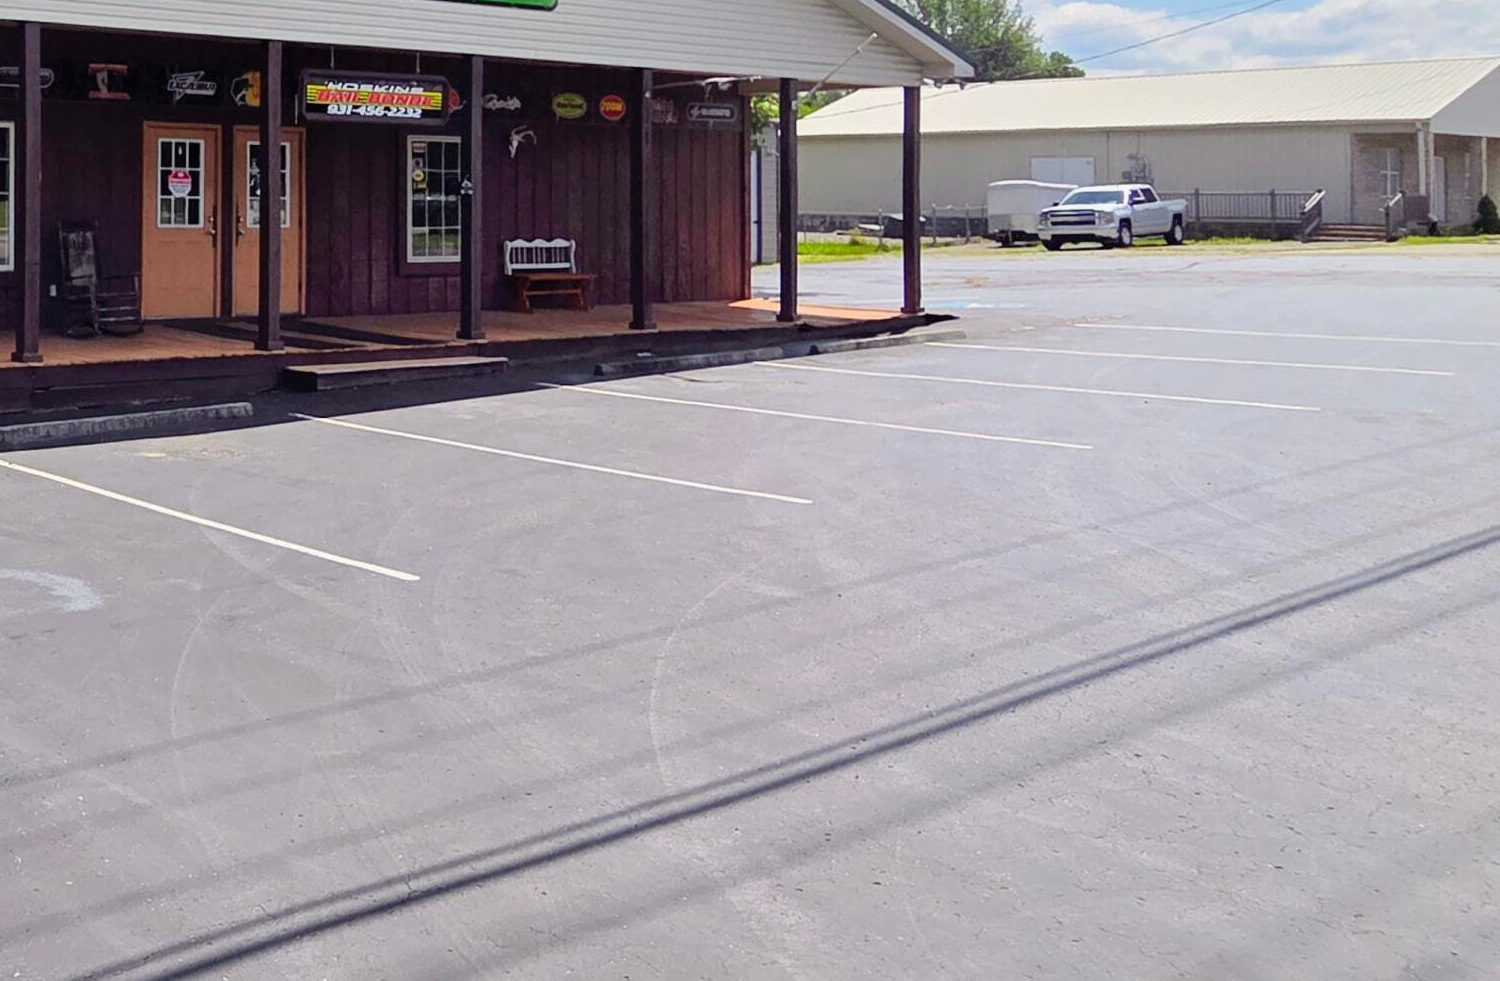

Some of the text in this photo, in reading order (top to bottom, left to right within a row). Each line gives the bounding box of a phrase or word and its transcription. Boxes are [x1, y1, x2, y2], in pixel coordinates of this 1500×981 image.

[326, 81, 424, 93] HOSKINS
[316, 90, 432, 107] BAIL BONDS
[327, 104, 422, 118] 931-456-2232
